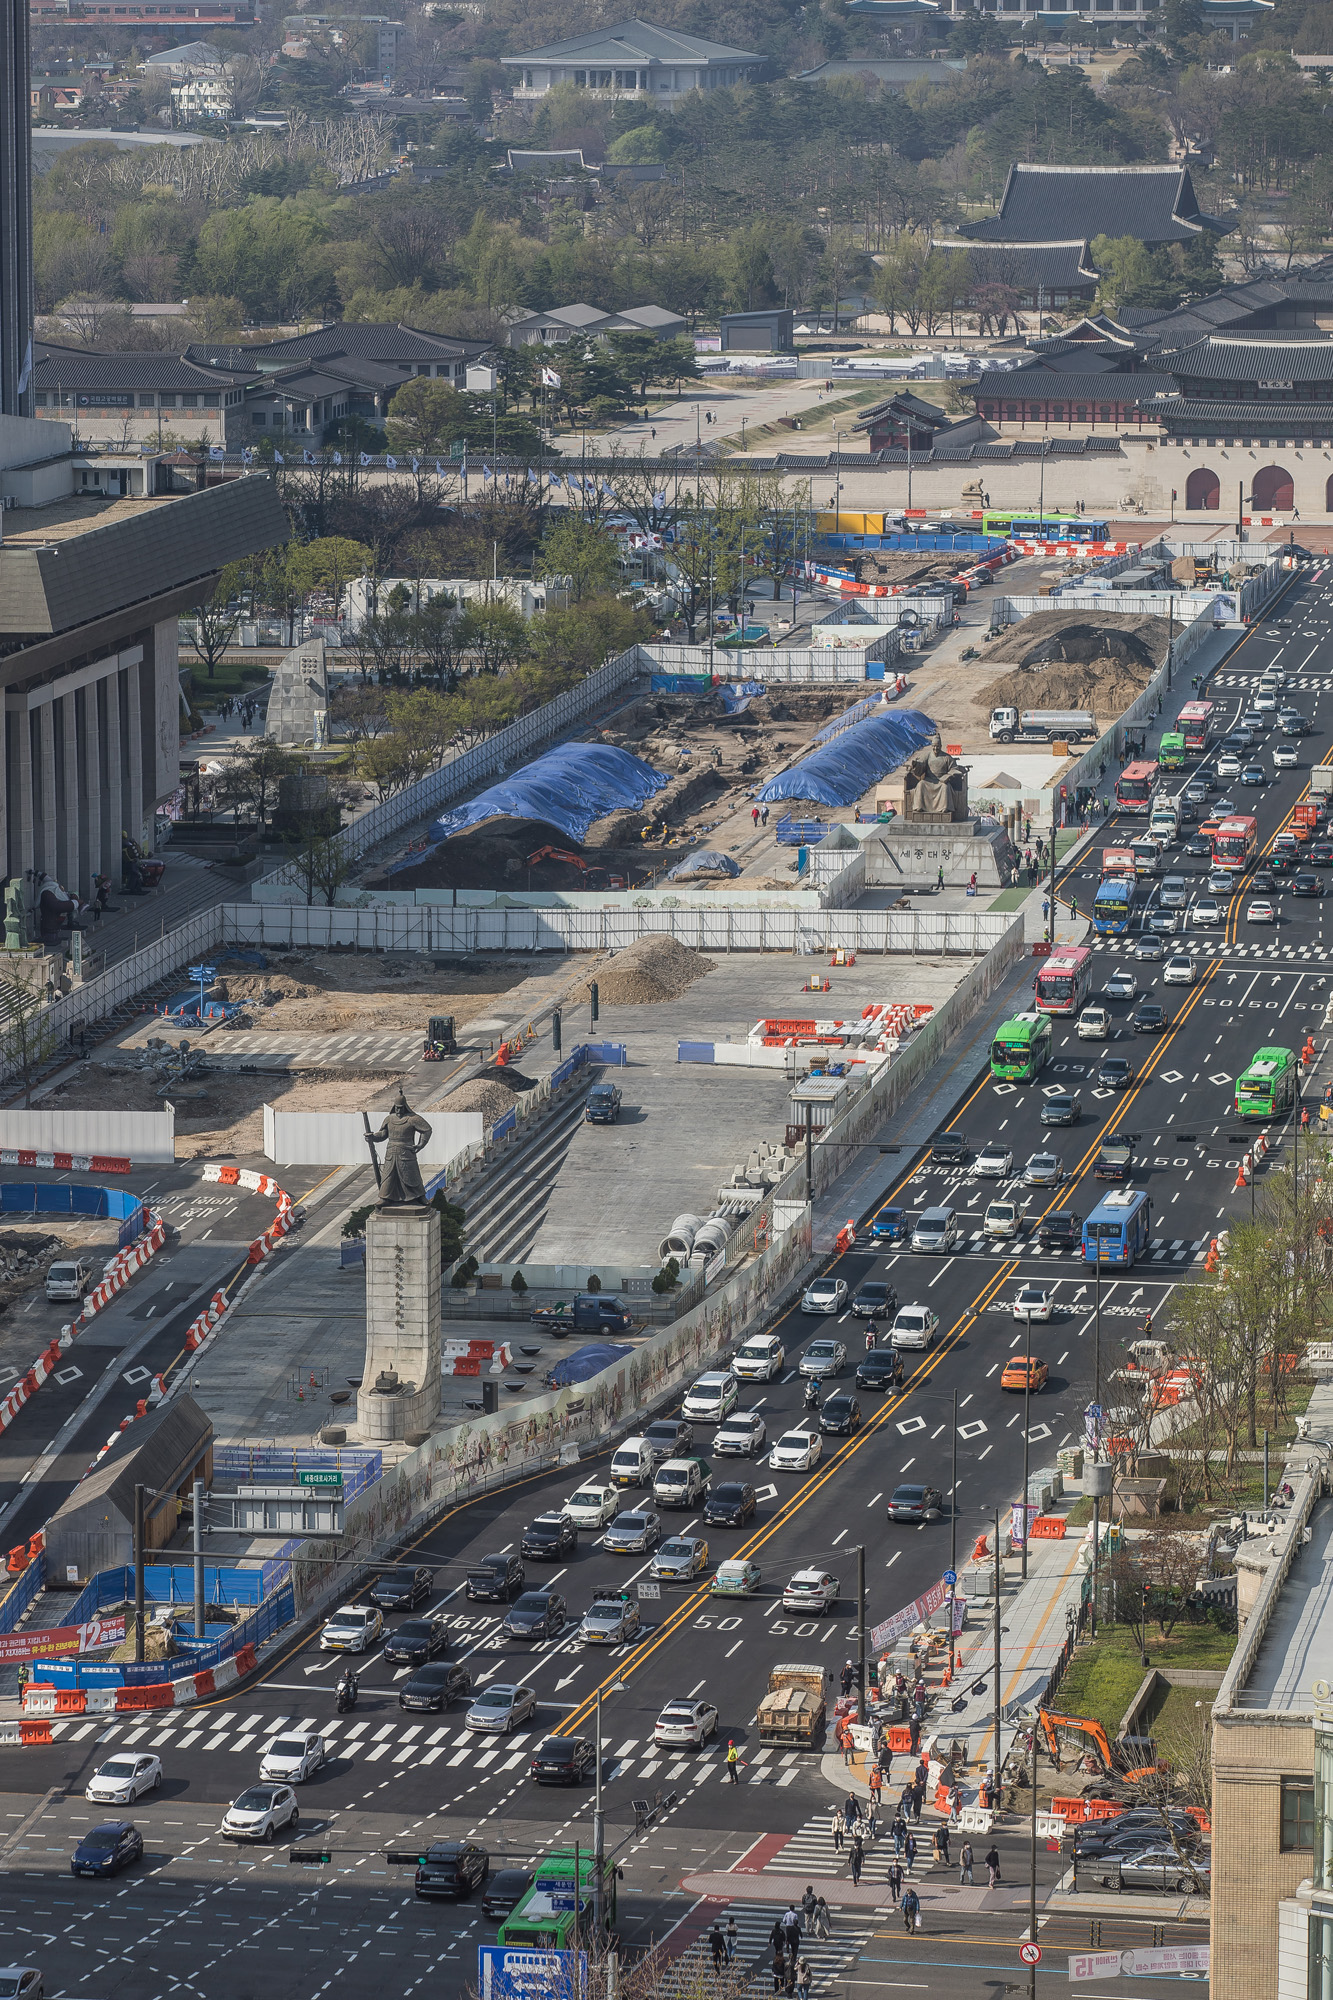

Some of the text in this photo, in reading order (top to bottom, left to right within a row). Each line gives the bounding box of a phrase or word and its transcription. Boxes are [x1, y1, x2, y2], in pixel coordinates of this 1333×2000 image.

[900, 848, 952, 860] 세종대왕
[1203, 998, 1232, 1006] 50
[1154, 1157, 1188, 1166] 50
[1206, 1159, 1240, 1168] 50
[304, 1474, 338, 1482] 세종대로사거리
[693, 1615, 743, 1630] 50
[768, 1620, 819, 1636] 50
[77, 1622, 100, 1652] 12
[100, 1627, 125, 1642] 송명숙
